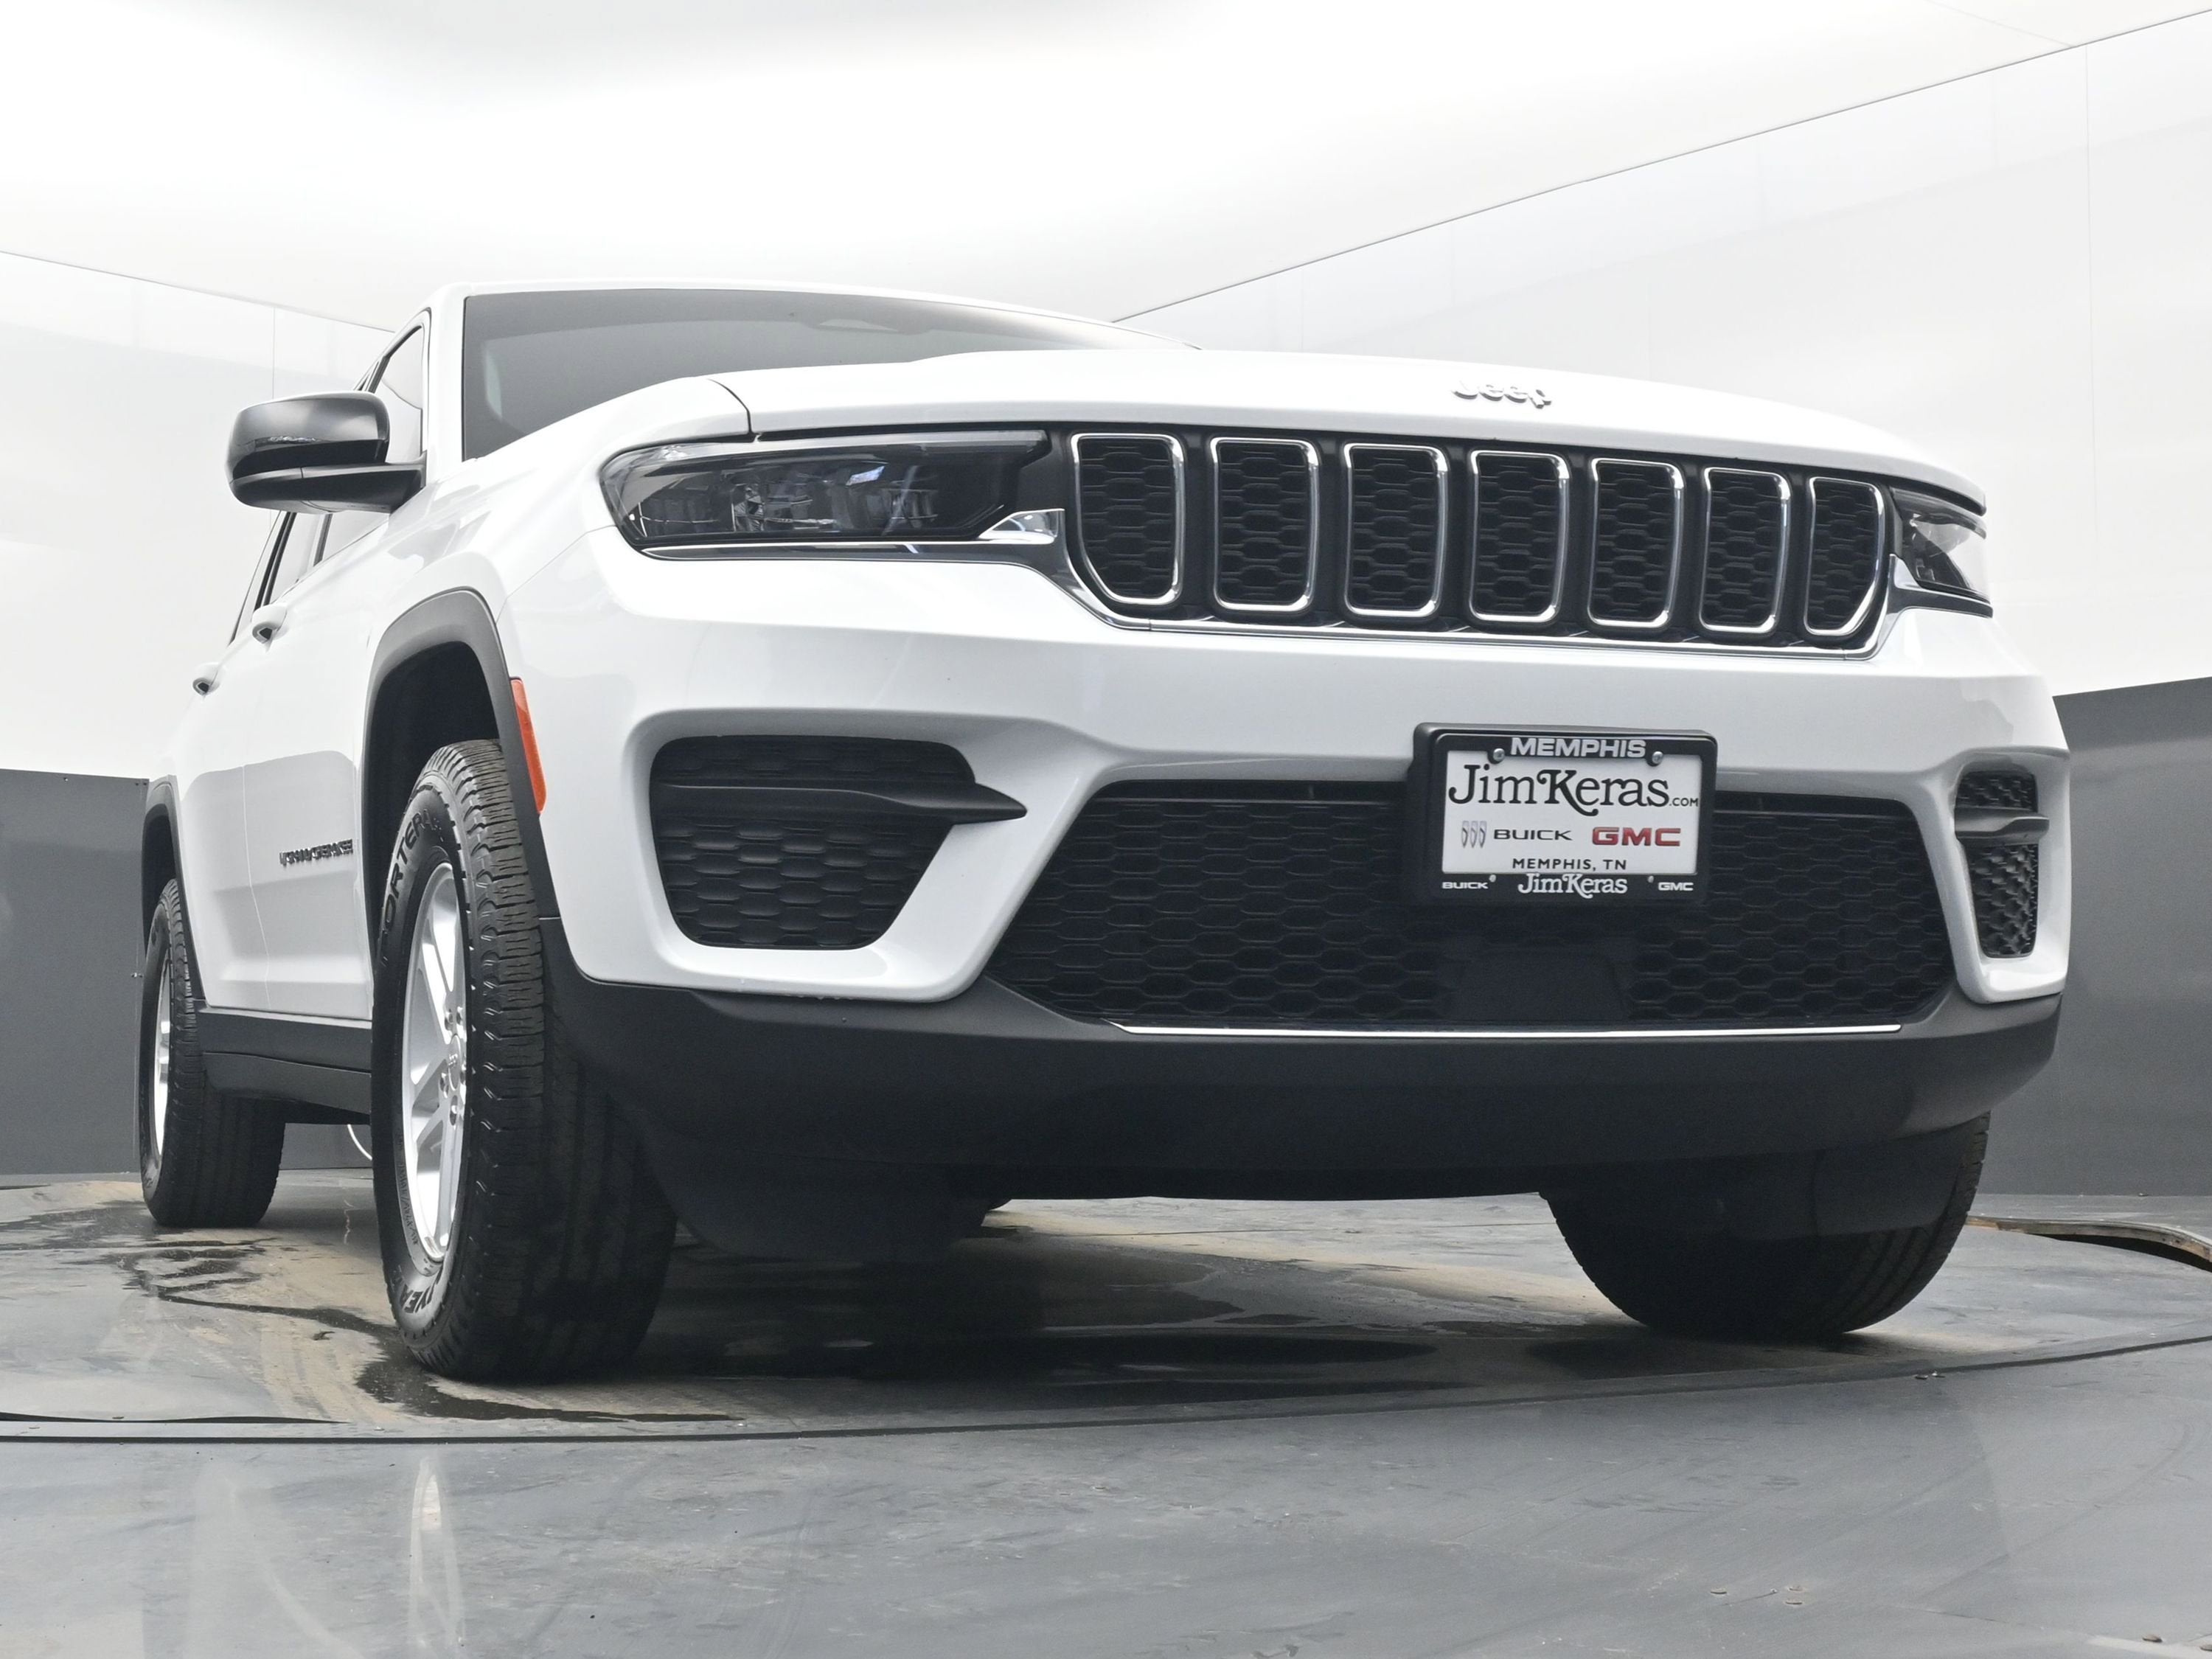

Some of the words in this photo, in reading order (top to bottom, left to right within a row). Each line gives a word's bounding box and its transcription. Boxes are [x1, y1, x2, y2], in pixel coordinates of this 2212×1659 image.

[1511, 737, 1646, 758] MEMPHIS
[1494, 830, 1573, 841] BUICK
[1592, 827, 1681, 846] GMC
[1512, 858, 1596, 872] MEMPHIS,
[1603, 859, 1627, 870] TN
[1658, 882, 1694, 891] GMC
